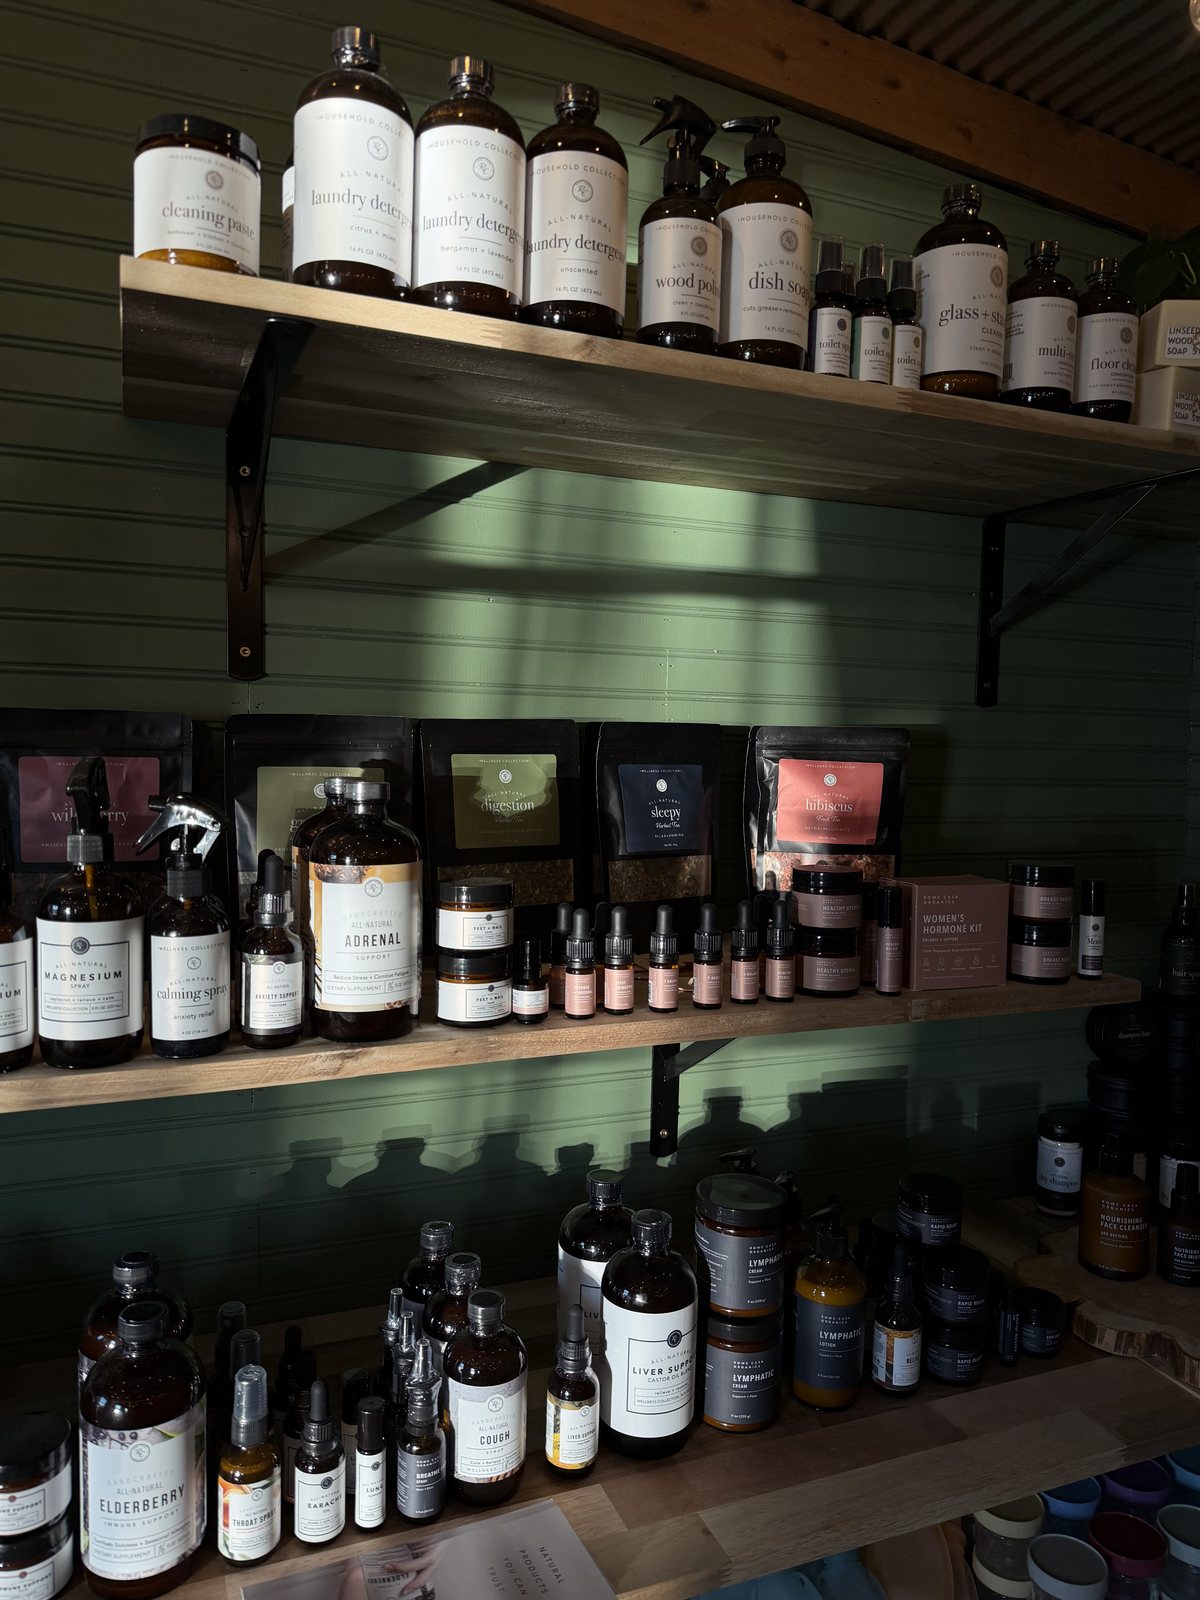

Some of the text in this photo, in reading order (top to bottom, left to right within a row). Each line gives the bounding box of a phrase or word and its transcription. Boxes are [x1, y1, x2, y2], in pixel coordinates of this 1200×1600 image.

[318, 112, 375, 126] HOUSEHOLD
[429, 139, 481, 150] HOUSEHOLD
[312, 188, 367, 210] laundry
[447, 191, 513, 216] ALL-NATURAL
[162, 201, 255, 241] cleaning paste
[423, 211, 473, 231] laundry
[547, 214, 613, 235] ALL-NATURAL
[740, 213, 788, 224] HOUSEHOLD
[350, 224, 373, 236] citrus
[658, 223, 698, 232] HOUSEHOLD
[525, 234, 571, 255] laundry
[440, 244, 514, 264] bergamot lavender
[954, 250, 998, 259] HOUSEHOLD
[560, 265, 598, 277] unscented
[655, 273, 695, 290] wood
[748, 270, 784, 292] dish
[672, 299, 688, 310] clean
[742, 305, 779, 316] cuts grease
[1169, 326, 1200, 335] LINSEED
[819, 336, 840, 350] toilet
[1168, 337, 1192, 345] WOOD
[864, 343, 886, 356] toilet
[1167, 347, 1188, 355] SOAP
[896, 352, 917, 366] toilet
[1090, 357, 1121, 371] floor
[1176, 391, 1198, 402] LINSEED
[1175, 402, 1193, 411] WOOD
[1174, 411, 1189, 420] SOAP
[486, 790, 527, 799] ALL-NATURAL
[810, 792, 849, 800] ALL-NATURAL
[480, 798, 535, 815] digestion
[805, 798, 853, 813] hibiscus
[651, 805, 681, 822] sleepy
[923, 913, 965, 924] WOMEN'S
[351, 920, 394, 930] ALL-NATURAL
[923, 923, 983, 935] HORMONE KIT
[344, 931, 402, 948] ADRENAL
[159, 941, 227, 953] WELLNESS COLLECTION
[356, 953, 392, 962] SUPPORT
[55, 961, 108, 971] ALL-NATURAL
[44, 970, 122, 982] MAGNESIUM
[333, 973, 352, 982] Reduce
[373, 972, 394, 981] Combat
[394, 969, 410, 979] Fatigue
[170, 977, 217, 987] ALL-NATURAL
[347, 984, 383, 992] SUPPLEMENT
[156, 982, 227, 1003] calming spray
[173, 1009, 215, 1022] anxiety relief
[1049, 1177, 1079, 1190] shampoo
[1100, 1214, 1144, 1225] NOURISHING
[1100, 1221, 1118, 1231] FACE
[749, 1246, 776, 1255] ORGANICS
[957, 1300, 973, 1308] RAPID
[820, 1318, 849, 1326] ORGANICS
[819, 1326, 864, 1342] LYMPHATIC
[819, 1340, 837, 1350] LOTION
[733, 1363, 762, 1371] ORGANICS
[957, 1357, 972, 1365] RAPID
[632, 1365, 664, 1377] LIVER
[732, 1368, 776, 1384] LYMPHATIC
[646, 1374, 671, 1384] CASTOR
[671, 1372, 680, 1381] OIL
[654, 1388, 671, 1396] relieve
[732, 1382, 748, 1390] CREAM
[636, 1394, 681, 1405] WELLNESS COLLECTION
[478, 1421, 511, 1432] ALL-NATURAL
[479, 1430, 511, 1446] COUGH
[567, 1432, 582, 1441] LIVER
[485, 1447, 506, 1456] SYRUP
[485, 1457, 502, 1466] Relieve
[107, 1468, 176, 1487] HANDCRAFTED
[416, 1468, 441, 1480] BREATHE
[116, 1482, 163, 1496] ALL-NATURAL
[99, 1482, 186, 1515] ELDERBERRY
[12, 1499, 43, 1513] SUPPORT
[104, 1508, 181, 1529] IMMUNE SUPPORT
[232, 1517, 258, 1528] THROAT
[144, 1531, 170, 1546] Seasonal
[94, 1548, 151, 1560] DIETARY SUPPLEMENT
[519, 1548, 549, 1595] PRODUCTS
[538, 1545, 565, 1586] NATURAL
[23, 1572, 53, 1589] SUPPORT
[486, 1565, 506, 1594] TRUST
[503, 1556, 529, 1597] YOU CAN
